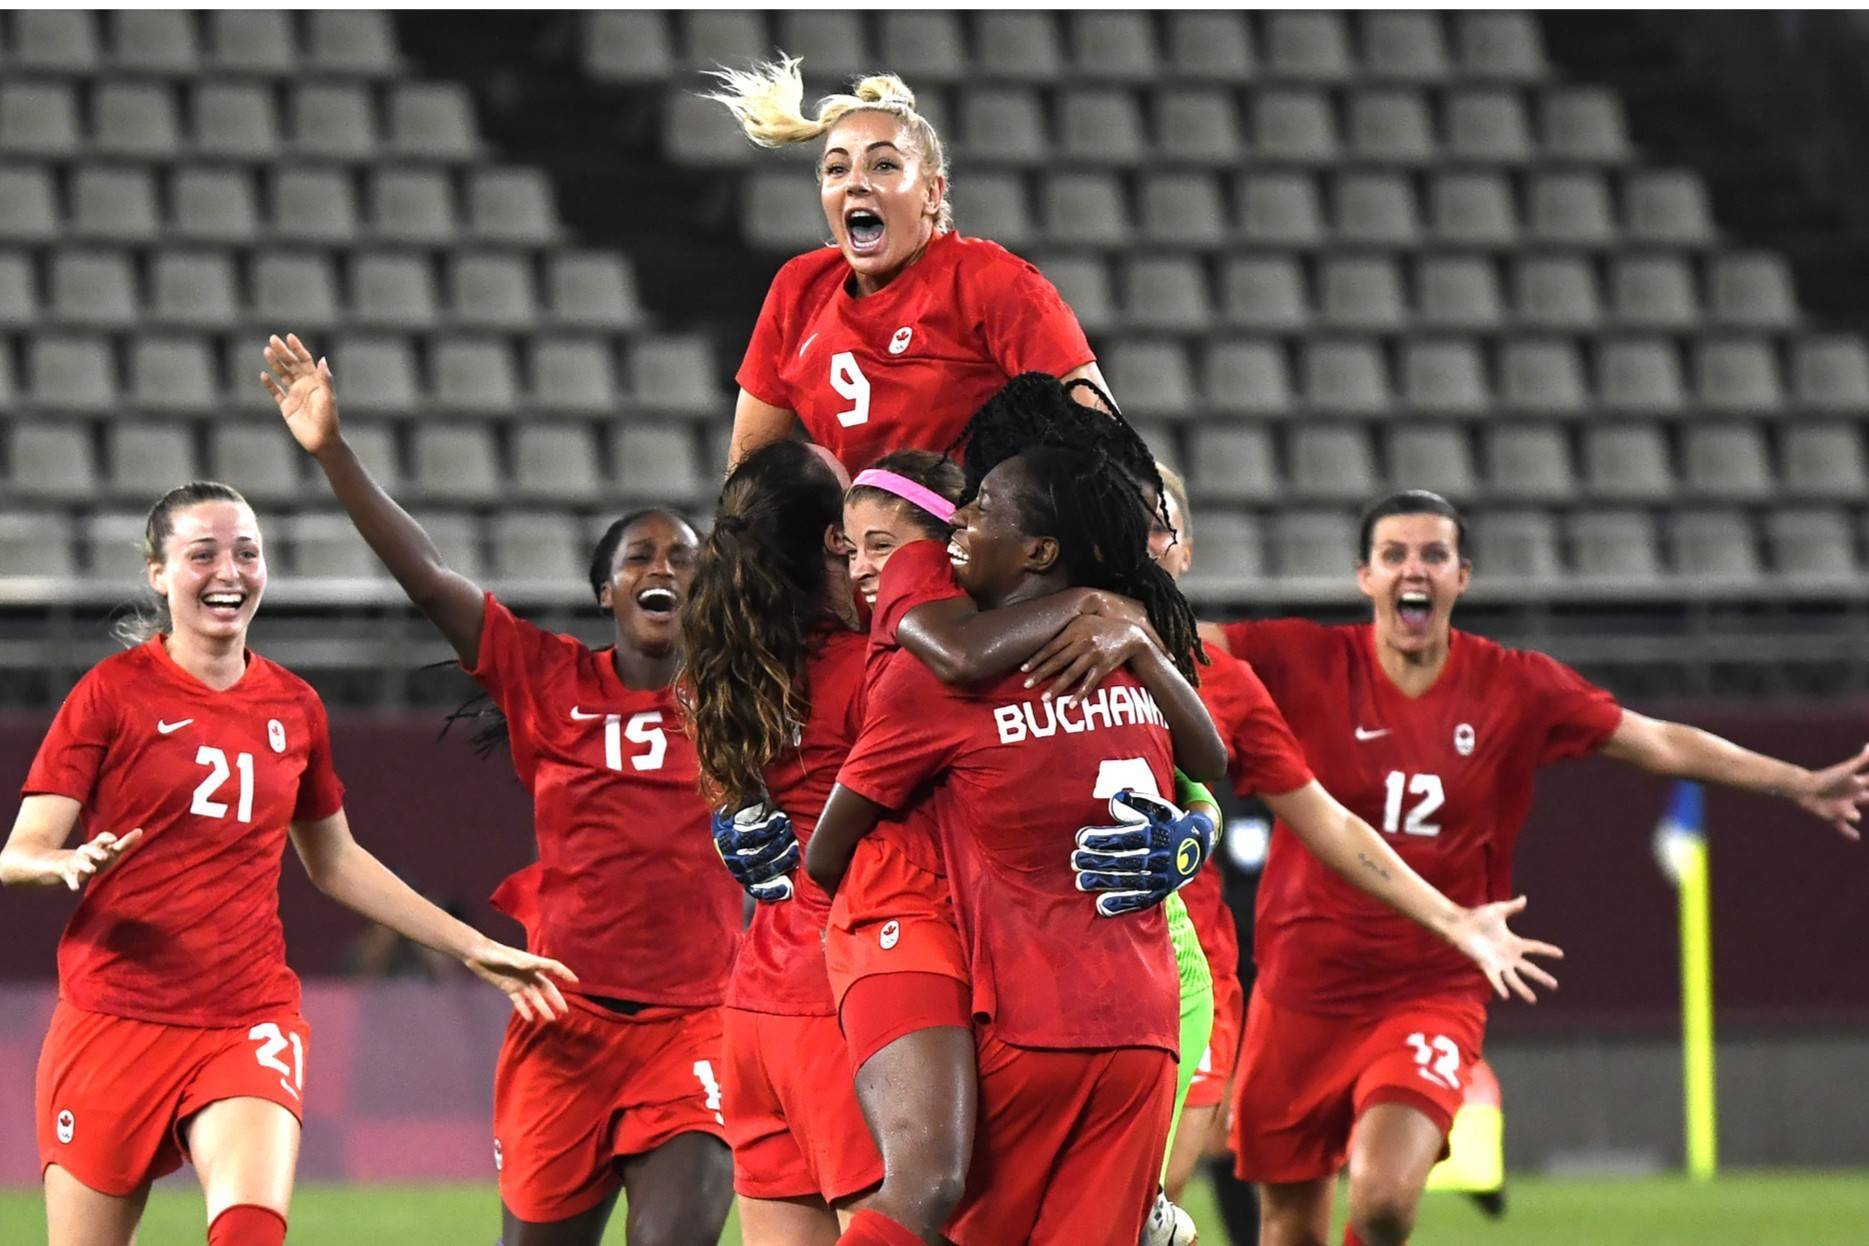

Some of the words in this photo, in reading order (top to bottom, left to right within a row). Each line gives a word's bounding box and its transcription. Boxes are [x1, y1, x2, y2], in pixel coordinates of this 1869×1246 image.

[829, 351, 871, 428] 9
[604, 711, 668, 772] 15
[993, 685, 1170, 745] BUCHANA
[189, 745, 255, 824] 21
[1383, 770, 1445, 837] 12
[248, 1022, 304, 1092] 21
